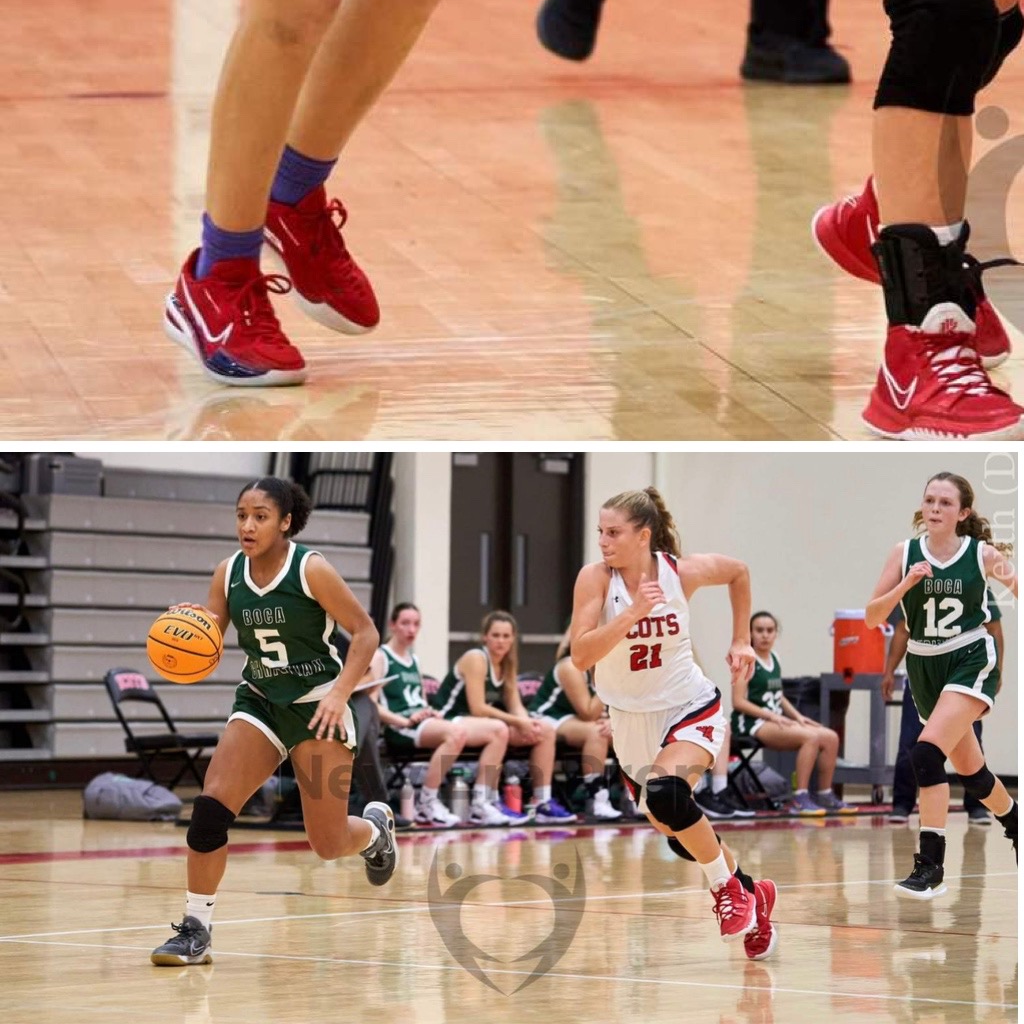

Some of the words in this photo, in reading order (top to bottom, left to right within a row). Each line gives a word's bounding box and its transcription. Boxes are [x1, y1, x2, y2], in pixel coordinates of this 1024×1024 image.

[924, 579, 963, 594] BOCA
[242, 606, 285, 626] BOCA
[923, 597, 964, 637] 12
[254, 629, 289, 668] 5
[629, 643, 662, 671] 21
